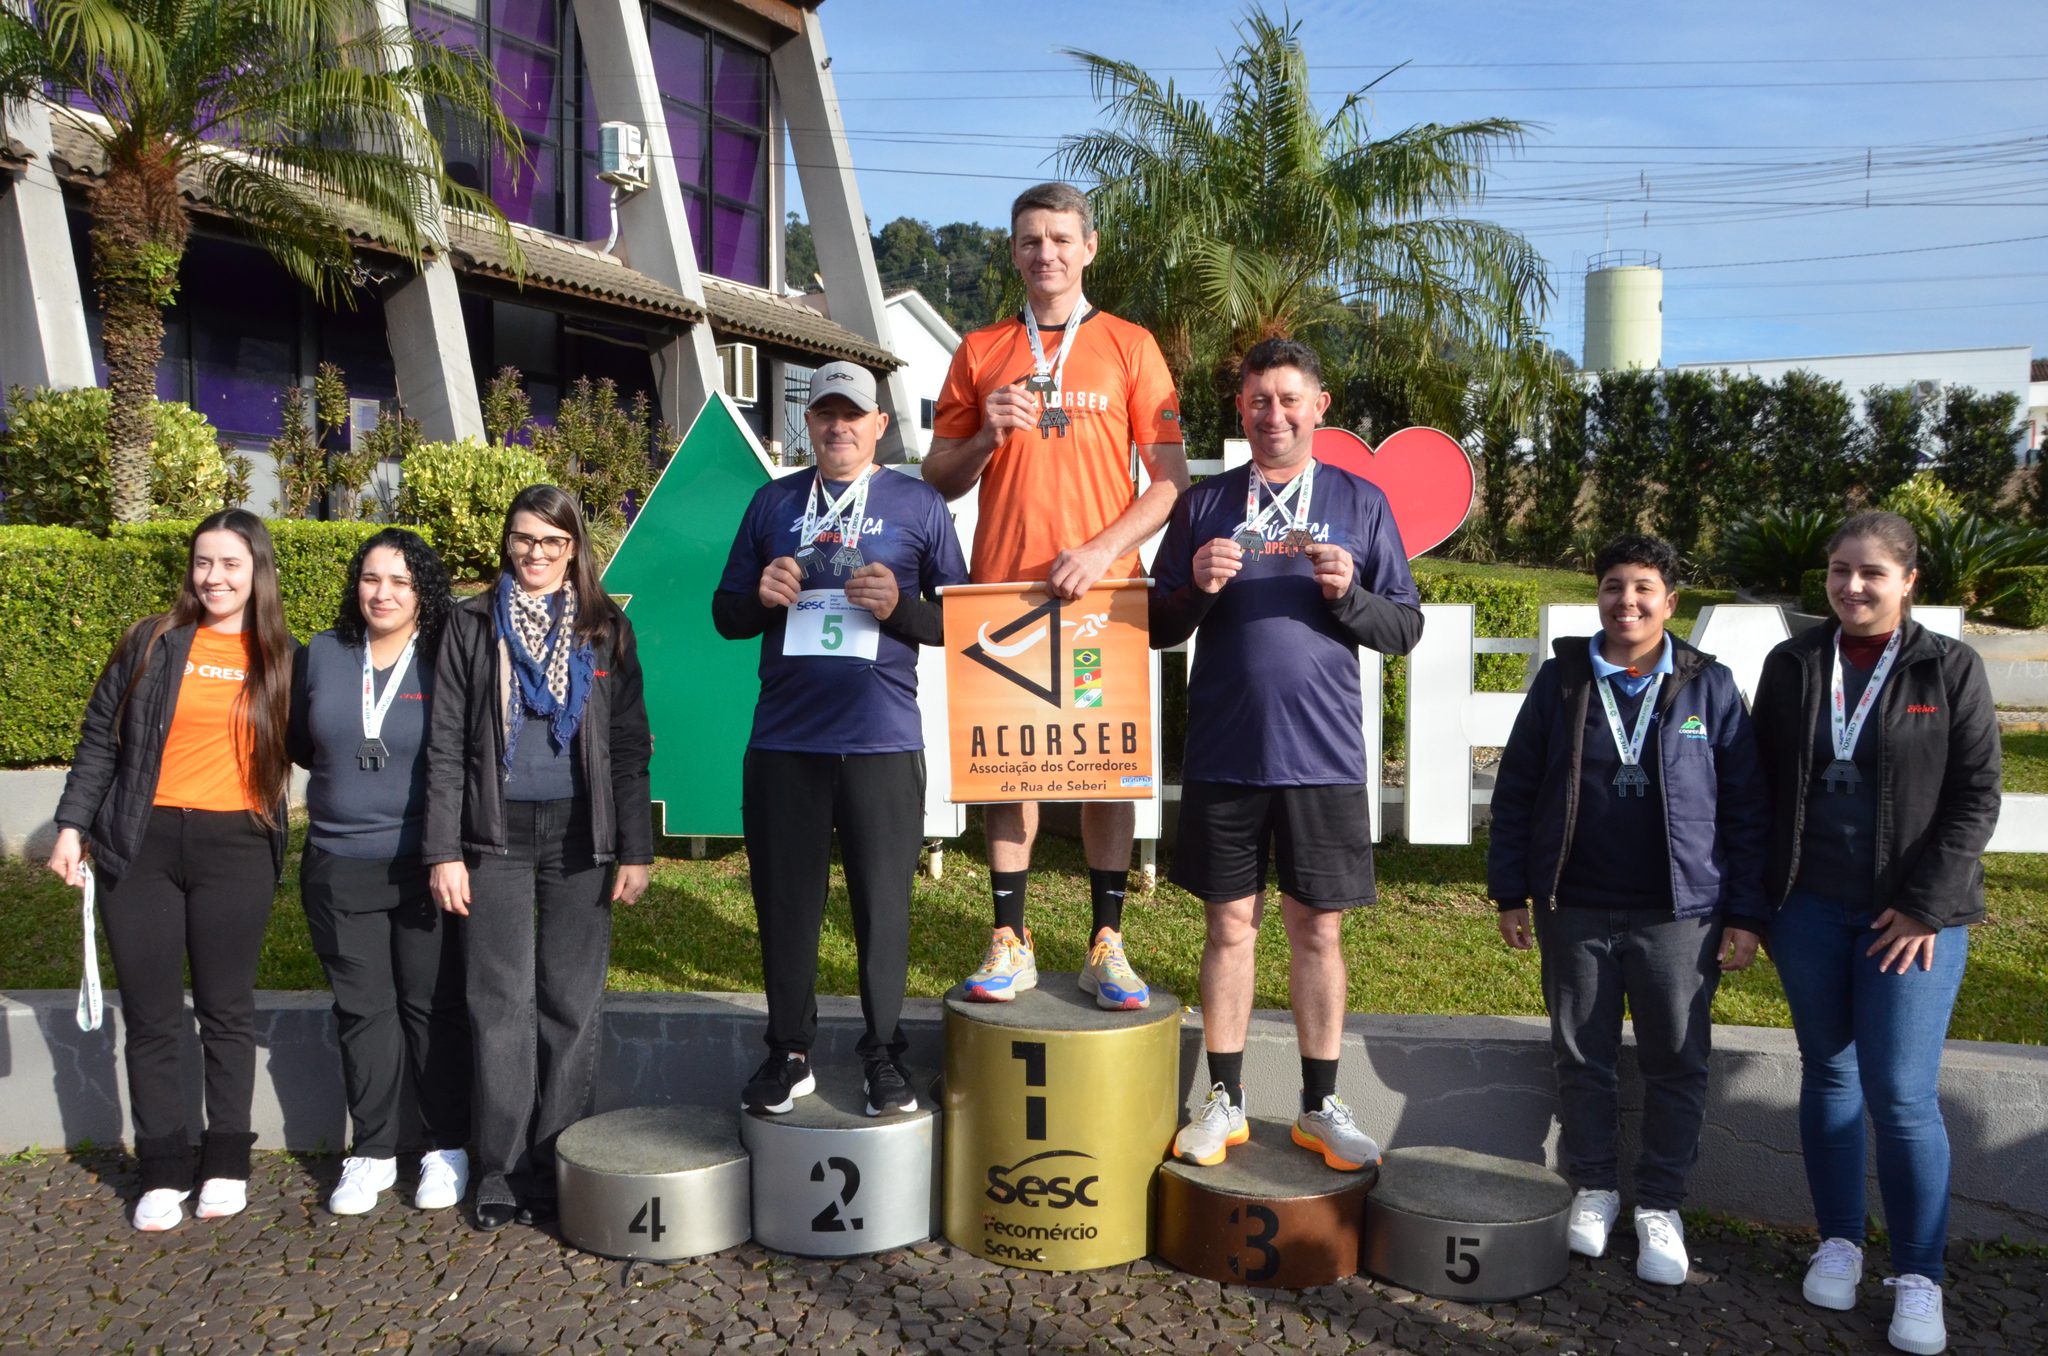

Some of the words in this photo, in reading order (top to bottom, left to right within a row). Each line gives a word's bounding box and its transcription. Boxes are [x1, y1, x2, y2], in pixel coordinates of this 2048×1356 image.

[820, 614, 843, 651] 5
[198, 664, 248, 681] CRES
[971, 722, 1137, 757] ACORSEB
[969, 761, 1036, 776] Associação
[1040, 761, 1063, 772] dos
[1067, 759, 1138, 771] Corredores
[1001, 782, 1016, 792] de
[1020, 782, 1043, 792] Rua
[1047, 781, 1063, 791] de
[1067, 780, 1107, 791] Seberi
[1011, 1040, 1047, 1141] 1
[810, 1156, 864, 1232] 2
[628, 1196, 666, 1242] 4
[1227, 1204, 1281, 1282] 3
[1444, 1236, 1481, 1285] 5
